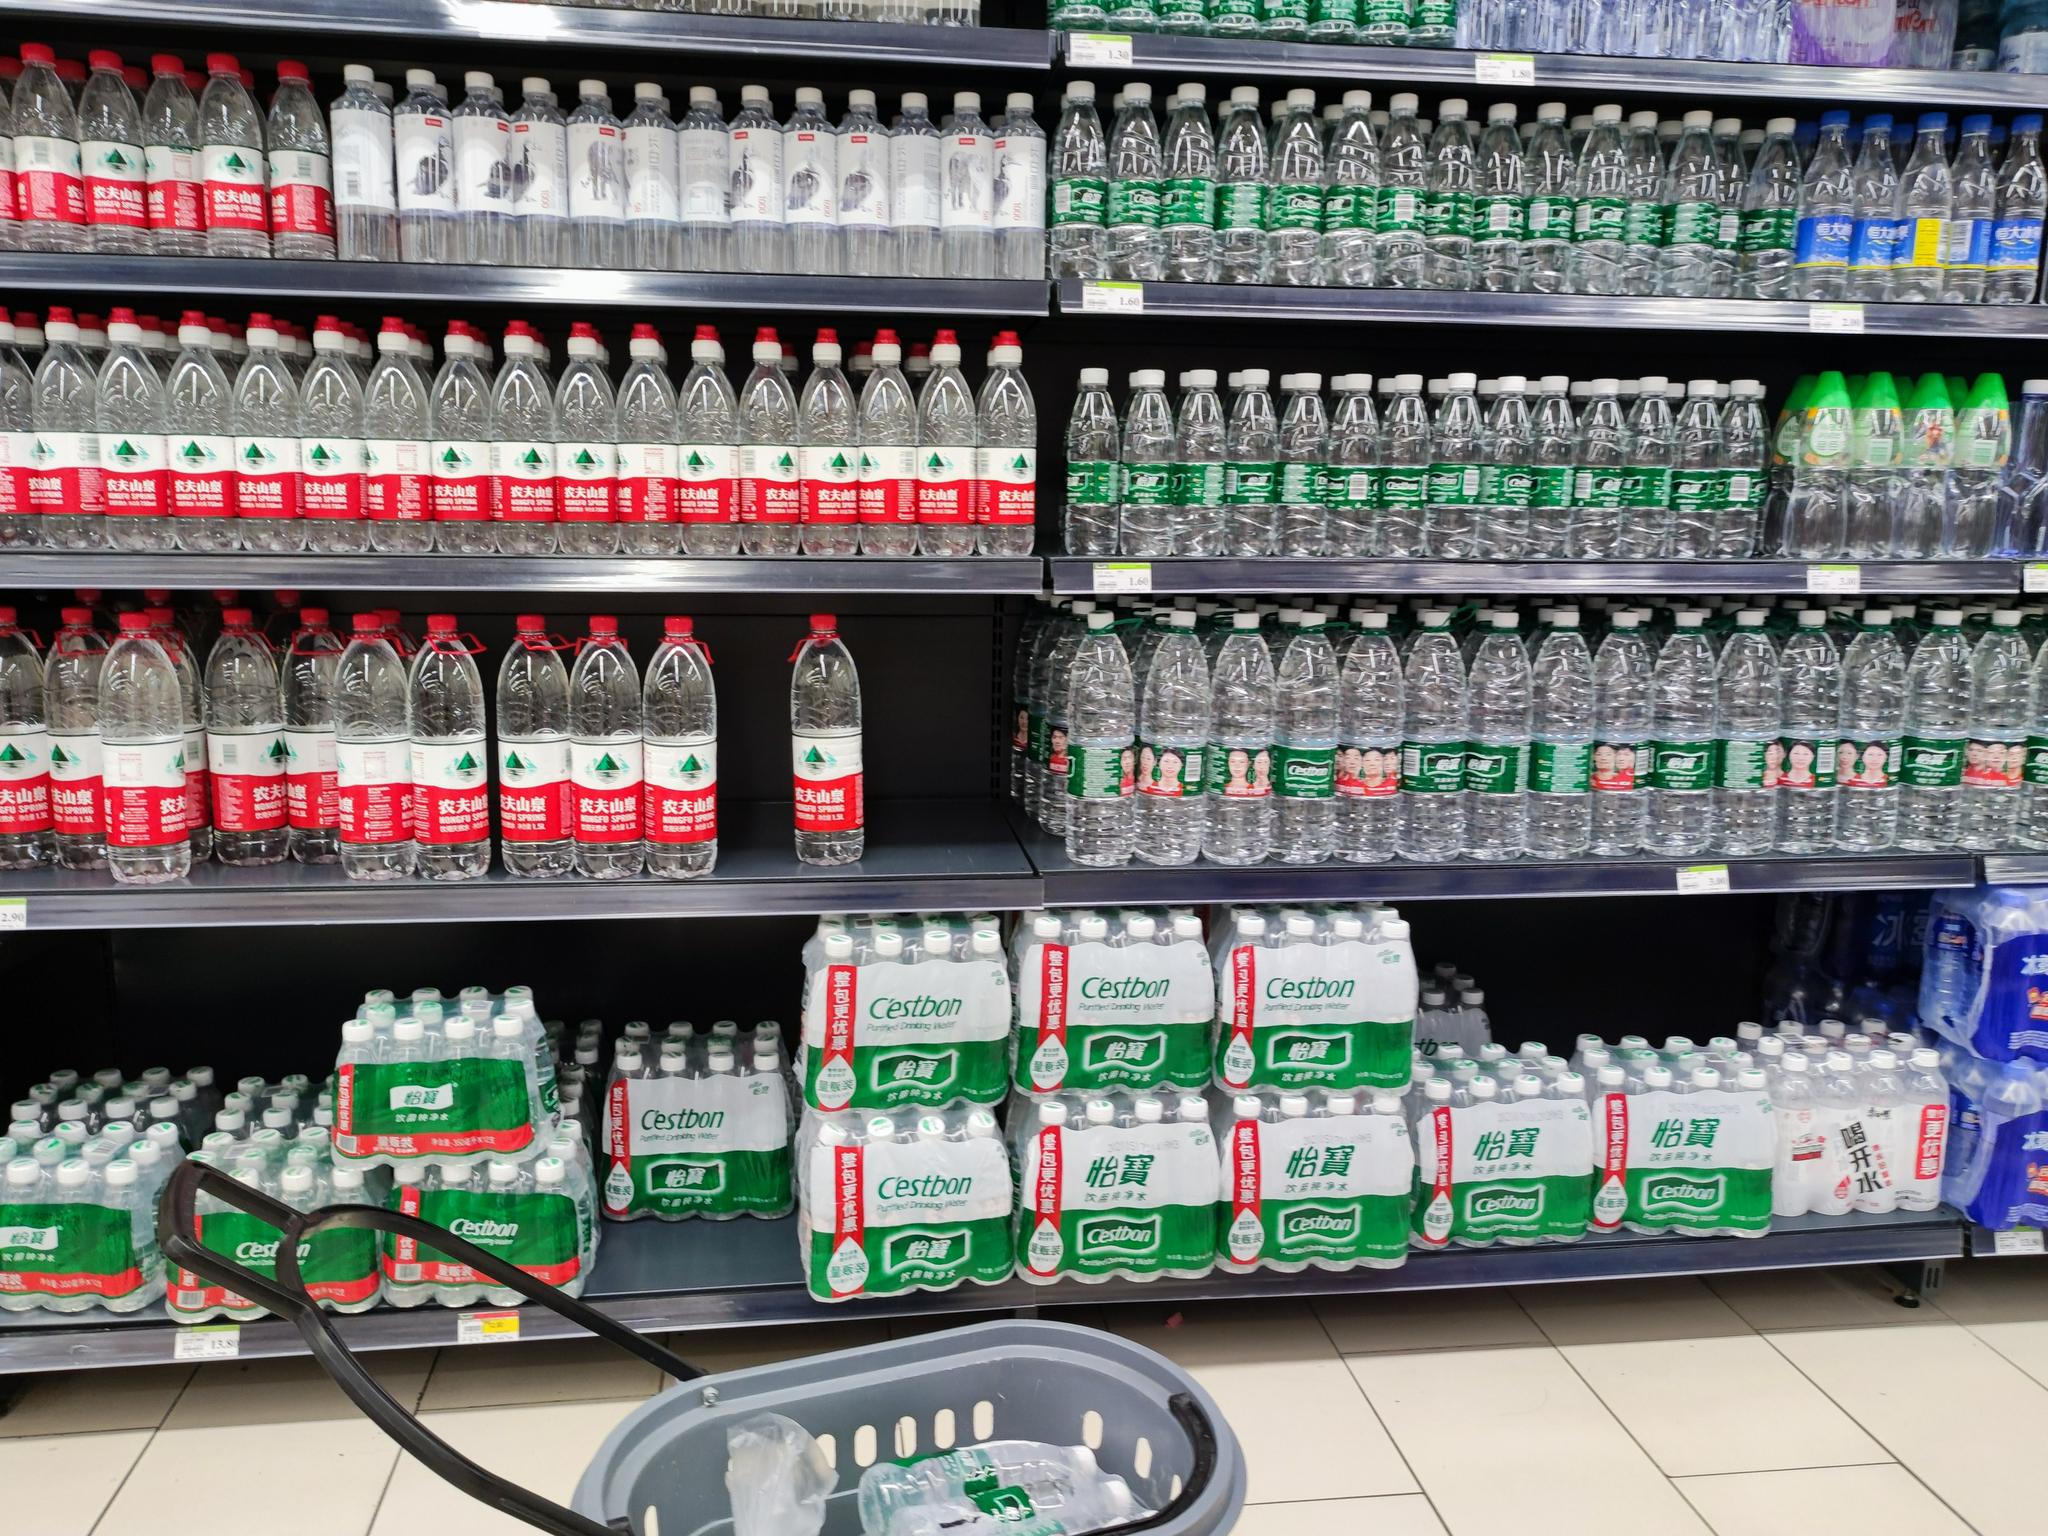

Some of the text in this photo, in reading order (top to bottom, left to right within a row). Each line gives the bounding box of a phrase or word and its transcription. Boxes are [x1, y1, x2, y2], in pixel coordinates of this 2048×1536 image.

[174, 480, 223, 494] 农夫山泉
[564, 486, 609, 499] 农夫山泉
[580, 796, 636, 814] 农夫山泉
[662, 796, 714, 814] 农夫山泉
[1473, 1127, 1540, 1161] 怡寶
[1651, 1118, 1720, 1149] 怡寶
[1085, 1154, 1155, 1188] 怡寶
[1285, 1145, 1355, 1179] 怡寶
[1840, 1121, 1883, 1194] 喝开水
